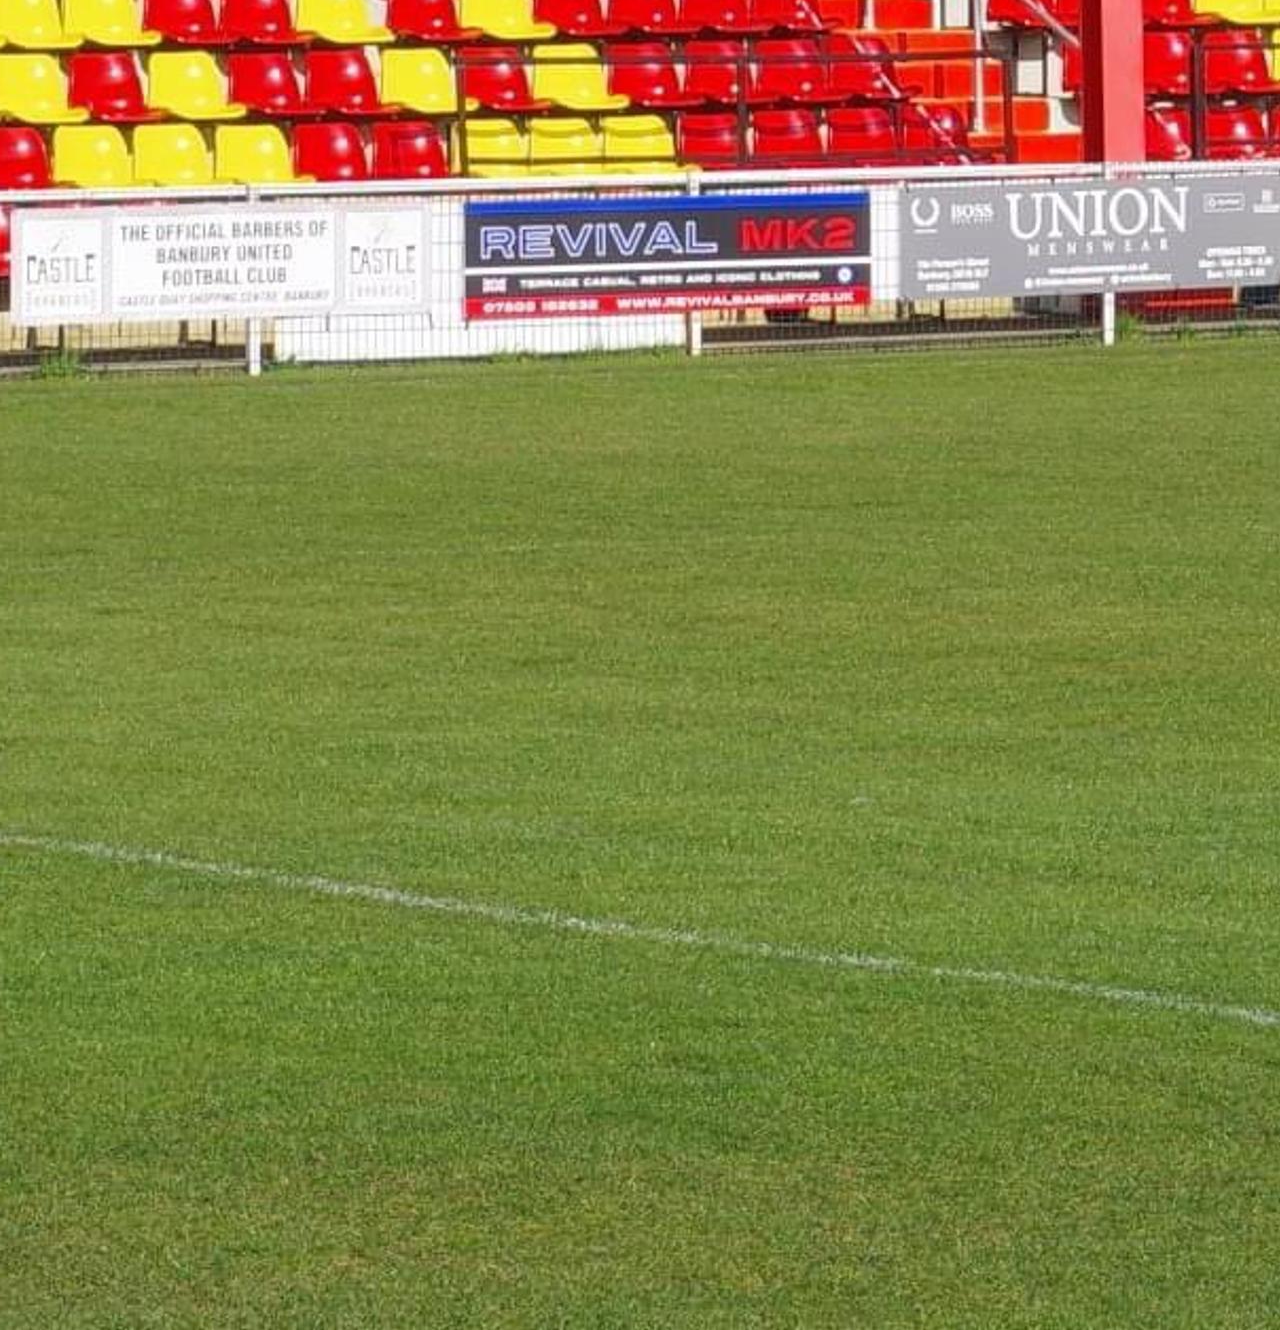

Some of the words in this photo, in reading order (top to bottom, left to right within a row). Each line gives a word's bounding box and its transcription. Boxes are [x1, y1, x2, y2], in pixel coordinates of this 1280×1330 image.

[951, 202, 994, 219] BOSS
[1005, 186, 1189, 240] UNION
[120, 224, 150, 242] THE
[155, 222, 225, 241] OFFICIAL
[232, 220, 304, 239] BARBERS
[309, 220, 329, 237] OF
[480, 220, 718, 260] REVIVAL
[739, 215, 856, 253] MK2
[156, 245, 230, 264] BANBURY
[237, 243, 293, 261] UNITED
[1026, 237, 1169, 257] MENSWEAR
[27, 254, 95, 283] CASTLE
[350, 245, 417, 275] CASTLE
[162, 268, 240, 288] FOOTBALL
[246, 266, 287, 284] CLUB
[686, 273, 713, 284] AND
